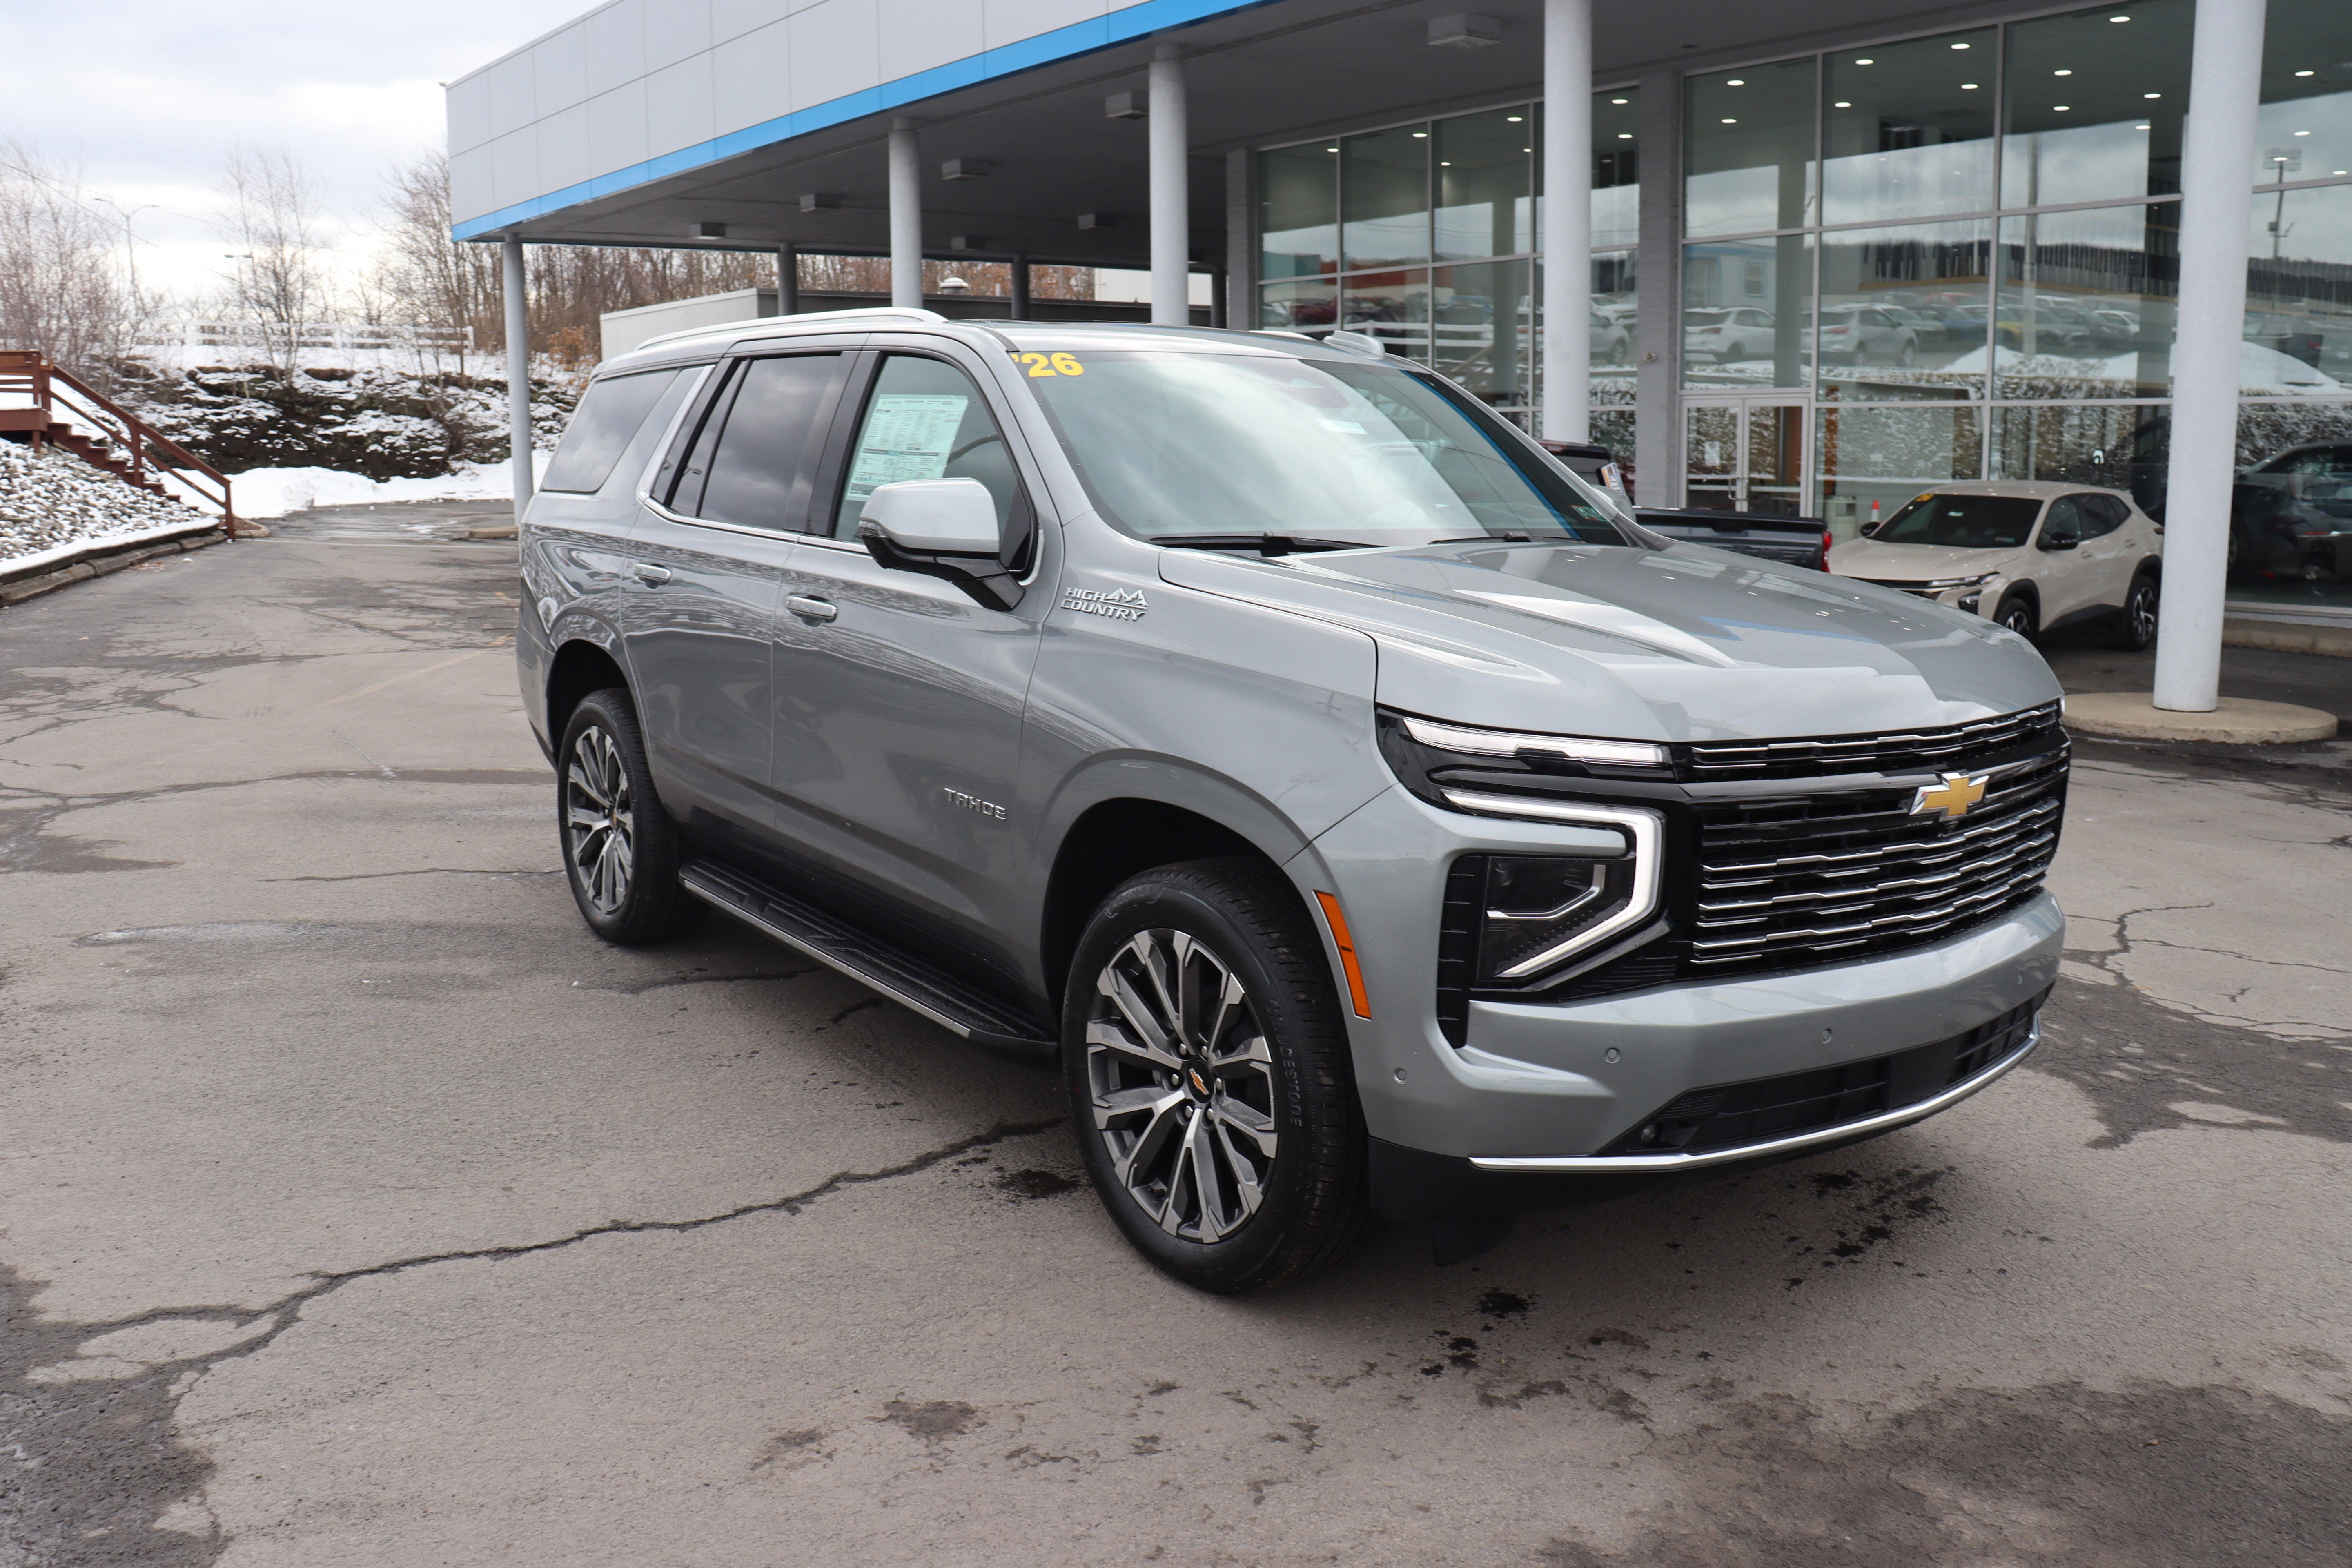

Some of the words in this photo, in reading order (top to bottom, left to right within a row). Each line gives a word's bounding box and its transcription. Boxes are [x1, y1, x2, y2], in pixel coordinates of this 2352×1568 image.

[1065, 587, 1107, 602] HIGH
[1060, 599, 1145, 621] COUNTRY
[944, 788, 1007, 821] TAHOE
